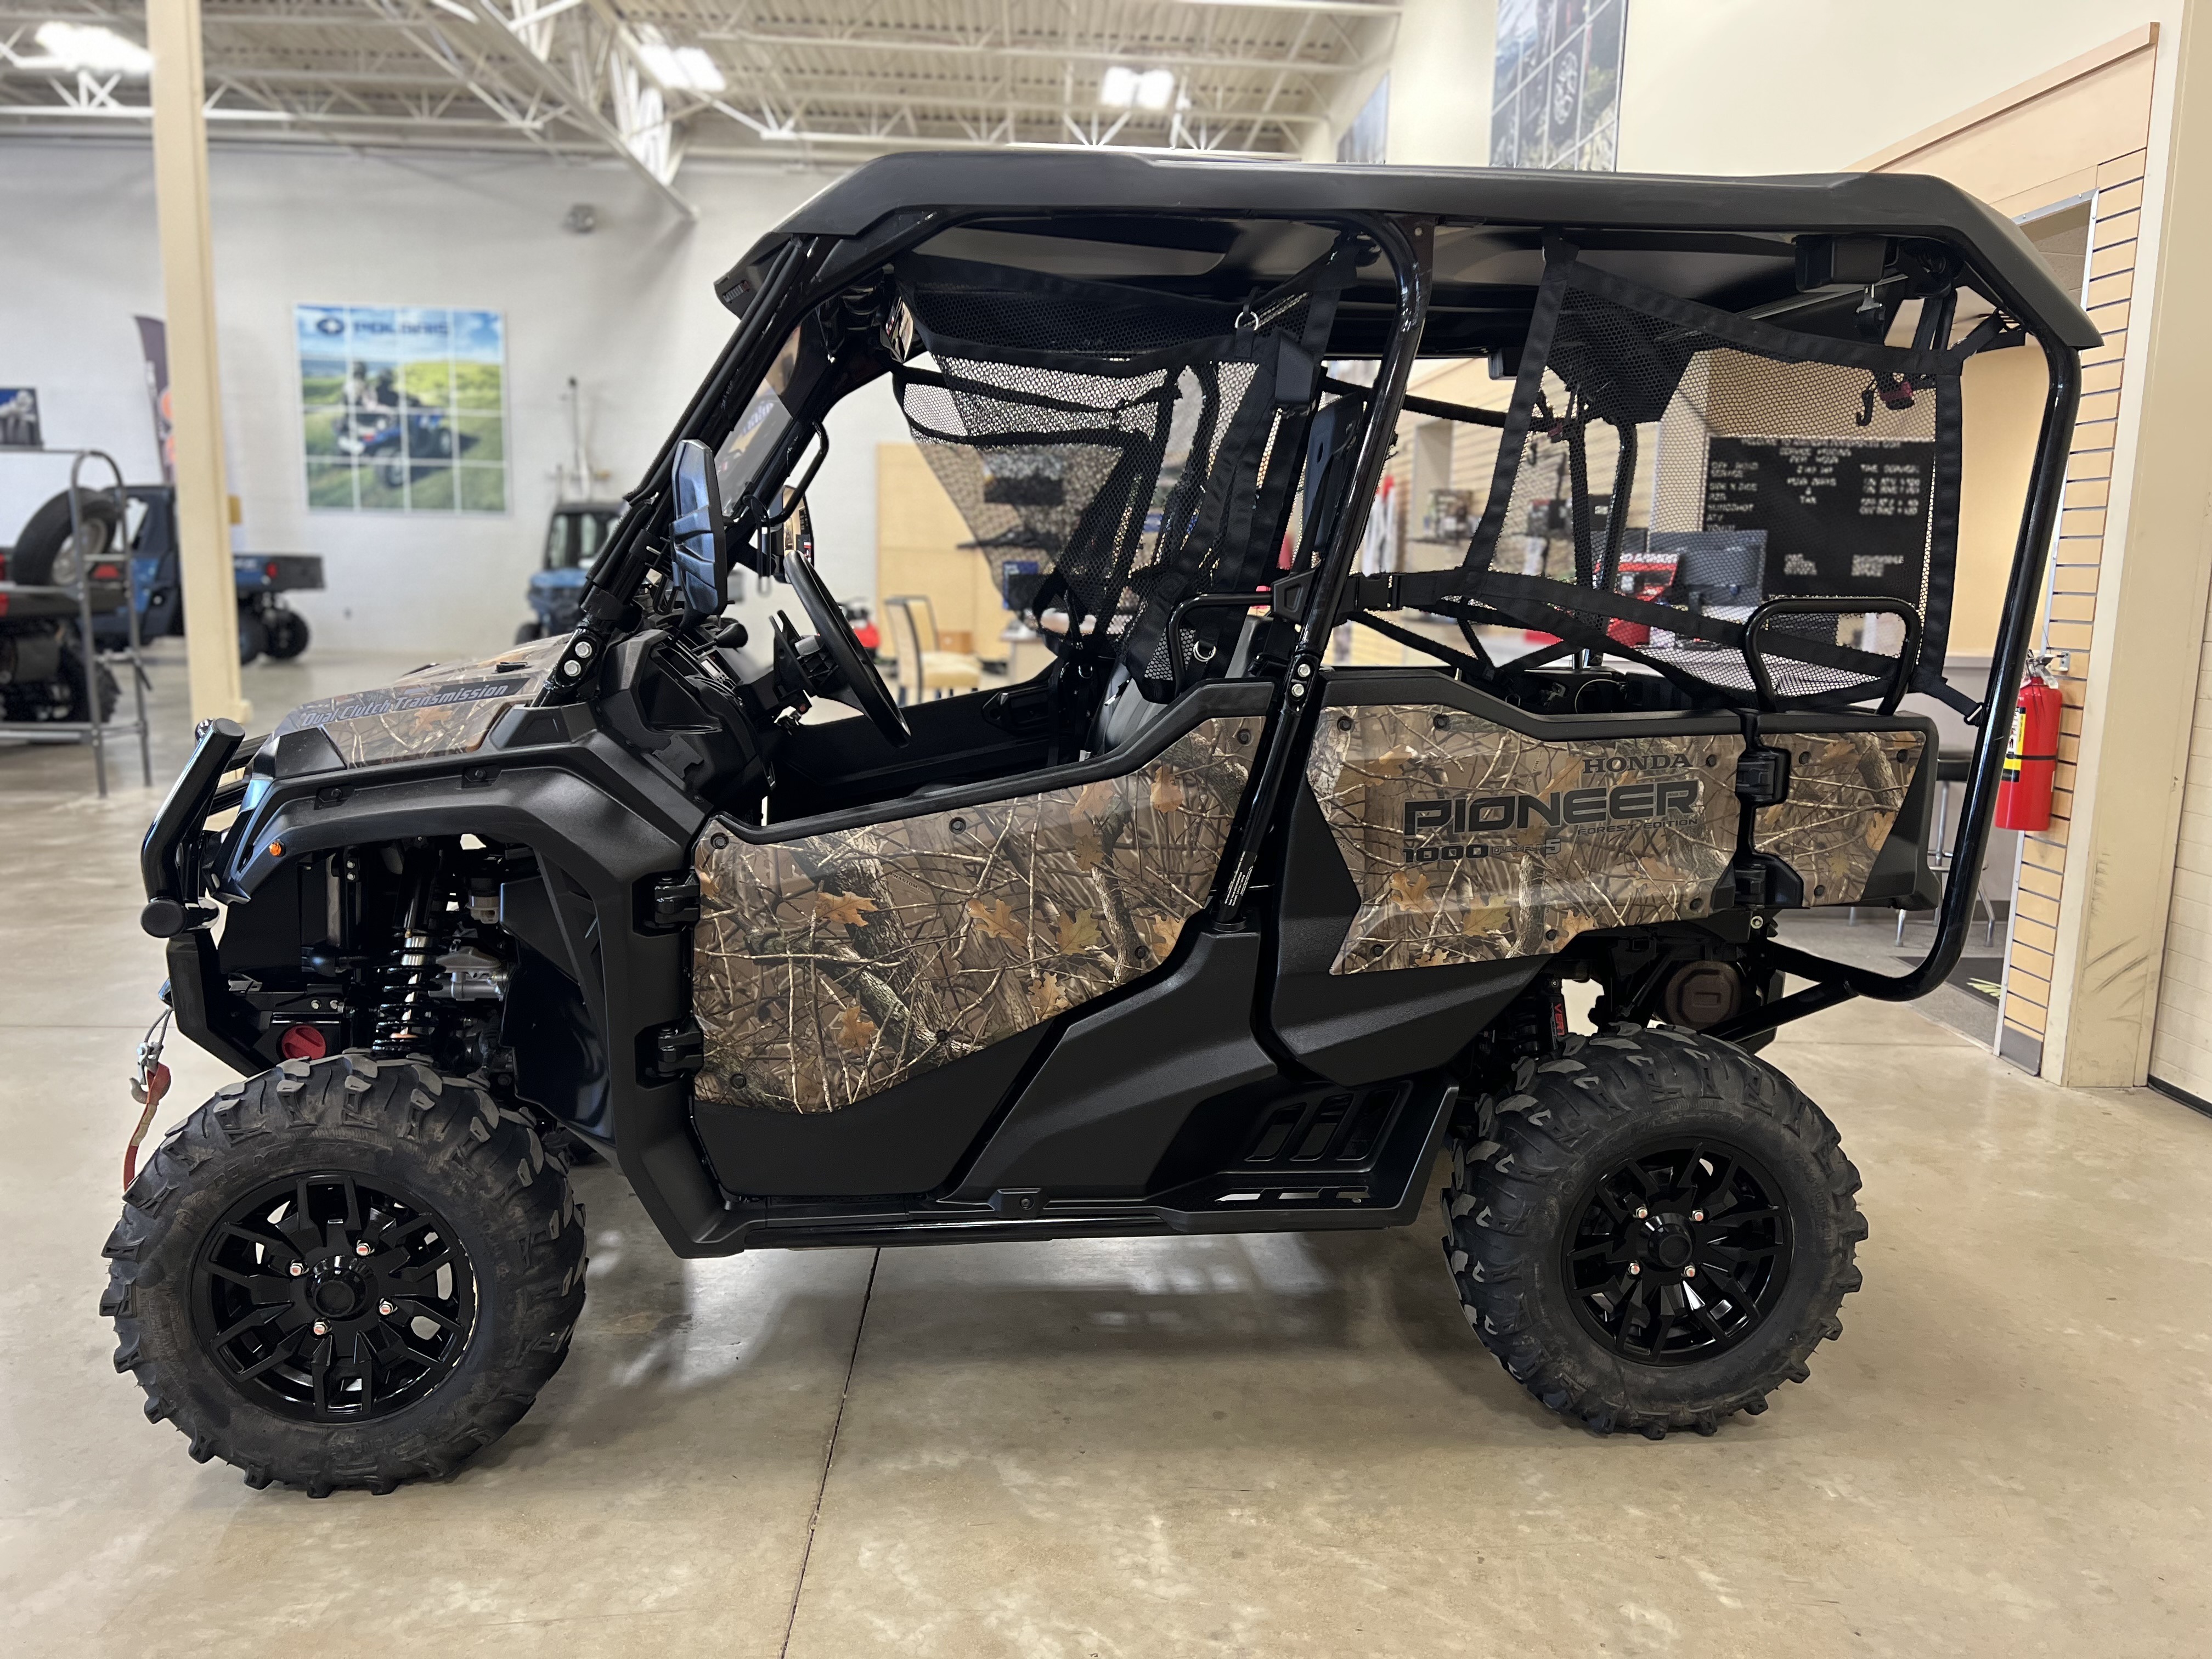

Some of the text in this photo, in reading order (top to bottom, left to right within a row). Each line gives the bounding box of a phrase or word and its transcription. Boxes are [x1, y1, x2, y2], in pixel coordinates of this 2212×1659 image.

[301, 684, 509, 727] Dual Clutch Transmission
[1582, 753, 1694, 775] HONDA
[1403, 779, 1701, 836] PIONEER
[1577, 818, 1699, 836] FOREST EDITION
[1402, 844, 1489, 864] 1000
